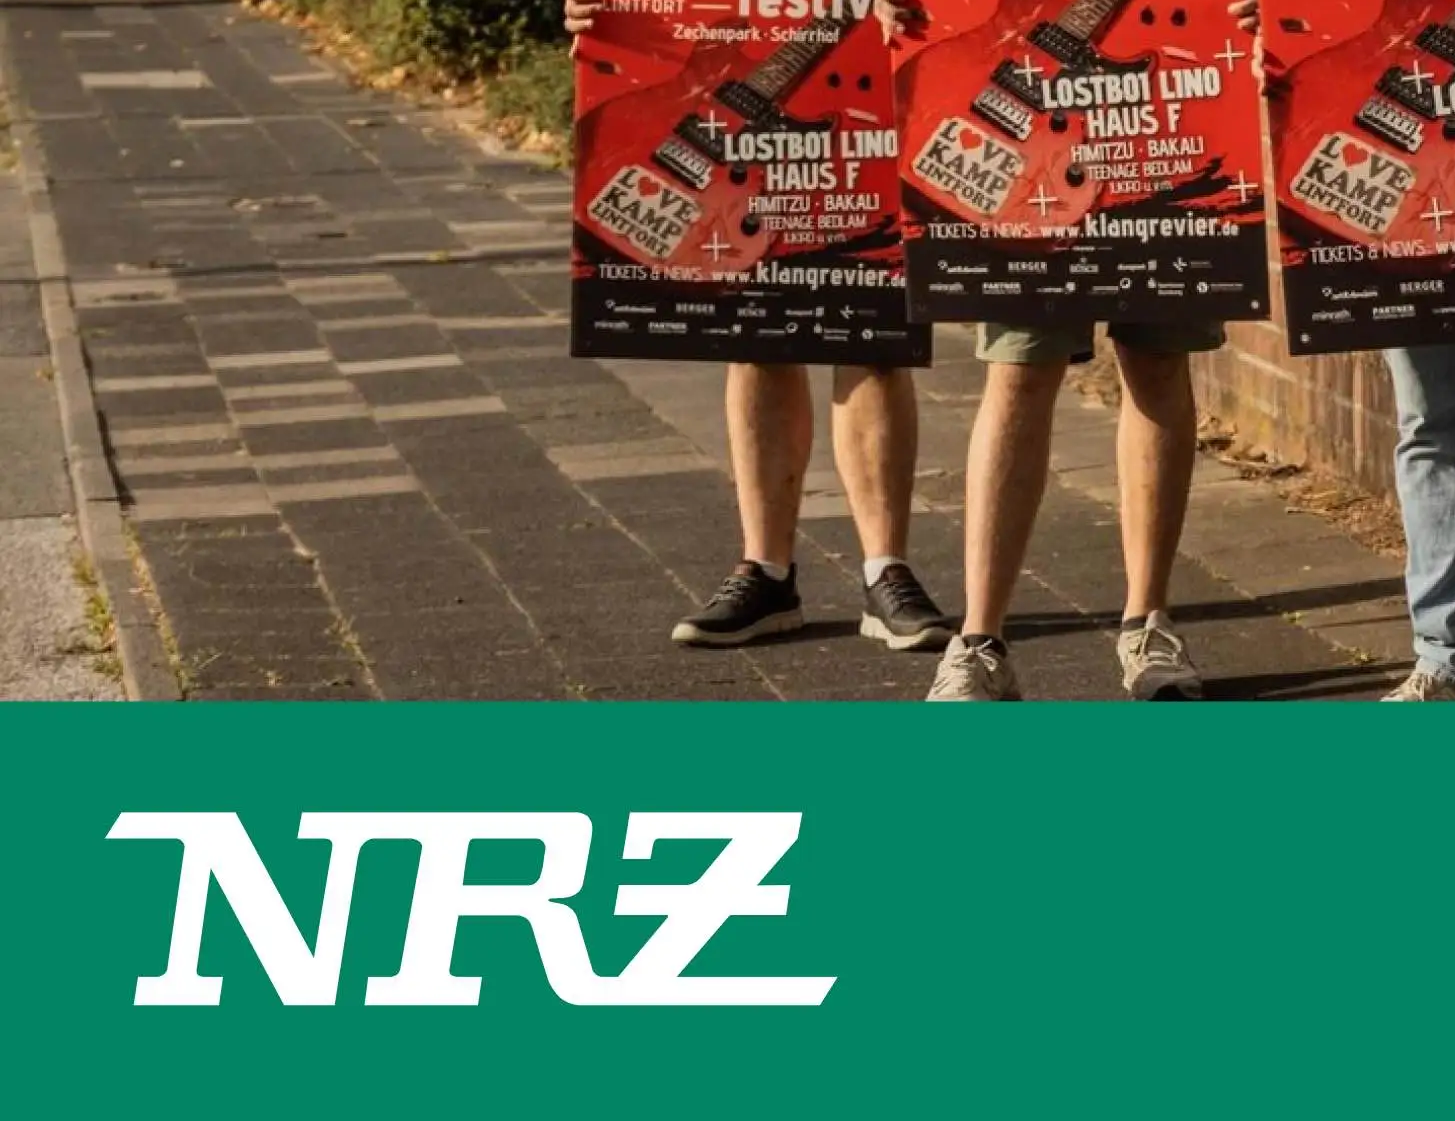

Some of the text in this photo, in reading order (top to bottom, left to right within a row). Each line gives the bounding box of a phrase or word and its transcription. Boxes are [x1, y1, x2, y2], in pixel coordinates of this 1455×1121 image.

[673, 24, 841, 44] Zechenpark Schirrhof
[1086, 102, 1182, 139] HAUS F
[766, 162, 860, 191] HAUS F
[1040, 212, 1240, 243] www.klangrevier.de
